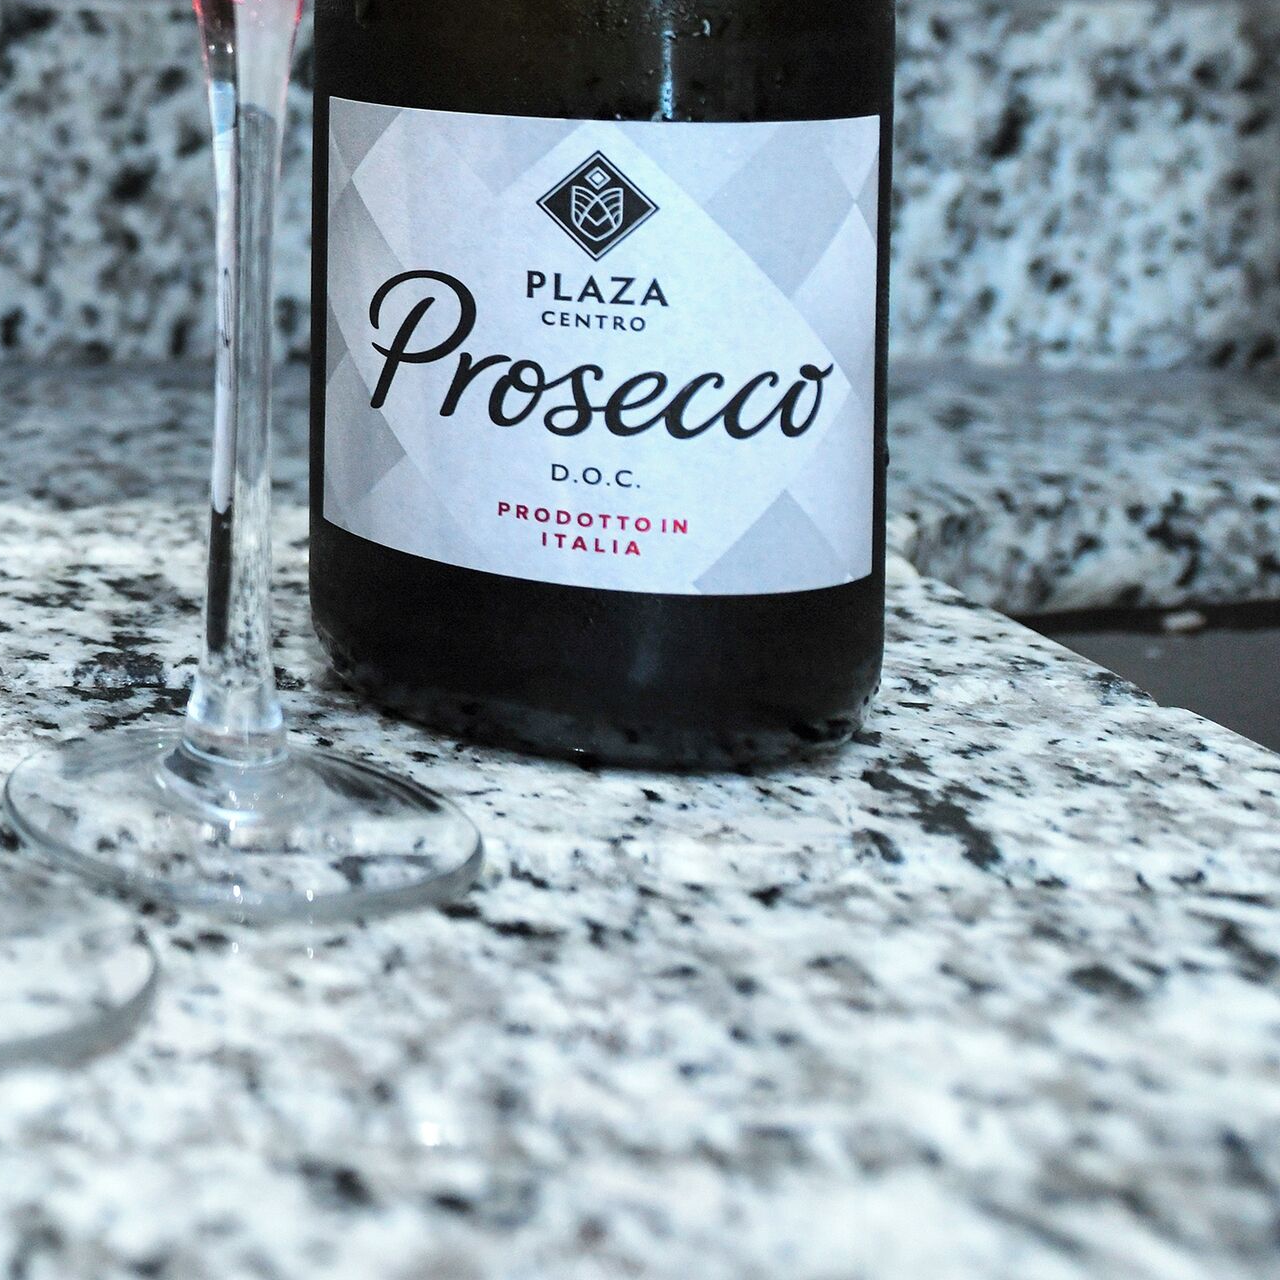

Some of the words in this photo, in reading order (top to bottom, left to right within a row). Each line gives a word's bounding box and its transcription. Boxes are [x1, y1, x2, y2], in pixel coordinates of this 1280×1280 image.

[526, 270, 669, 308] PLAZA
[541, 310, 646, 332] CENTRO
[369, 269, 834, 440] Prosecco
[551, 463, 641, 489] D.O.C.
[498, 501, 652, 533] PRODOTTO
[661, 517, 688, 535] IN
[542, 532, 642, 556] ITALIA
